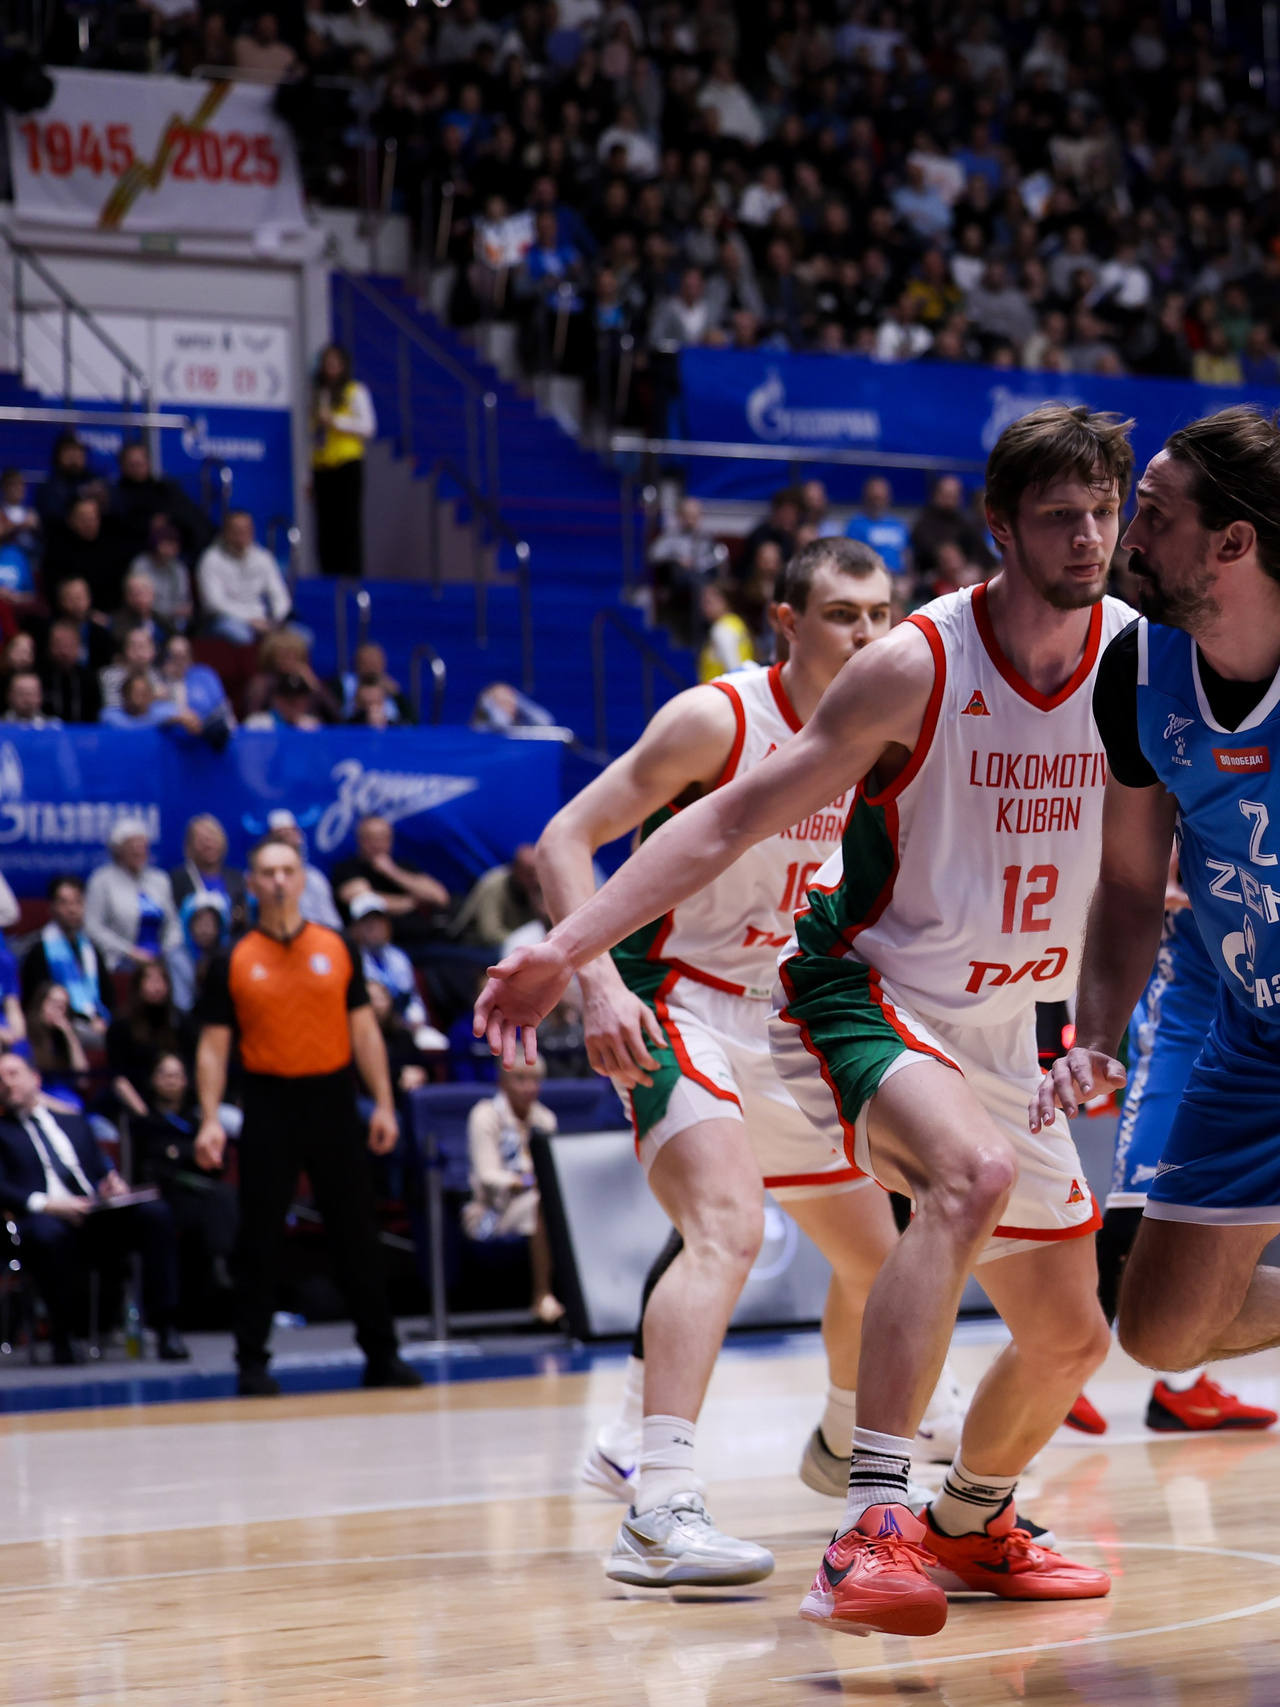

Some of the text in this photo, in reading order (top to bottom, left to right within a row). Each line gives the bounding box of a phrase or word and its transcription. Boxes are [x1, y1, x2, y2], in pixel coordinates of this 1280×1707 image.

[21, 120, 280, 187] 1945 2025
[995, 796, 1082, 834] KUBAN
[1239, 799, 1278, 866] 2
[1001, 864, 1059, 934] 12
